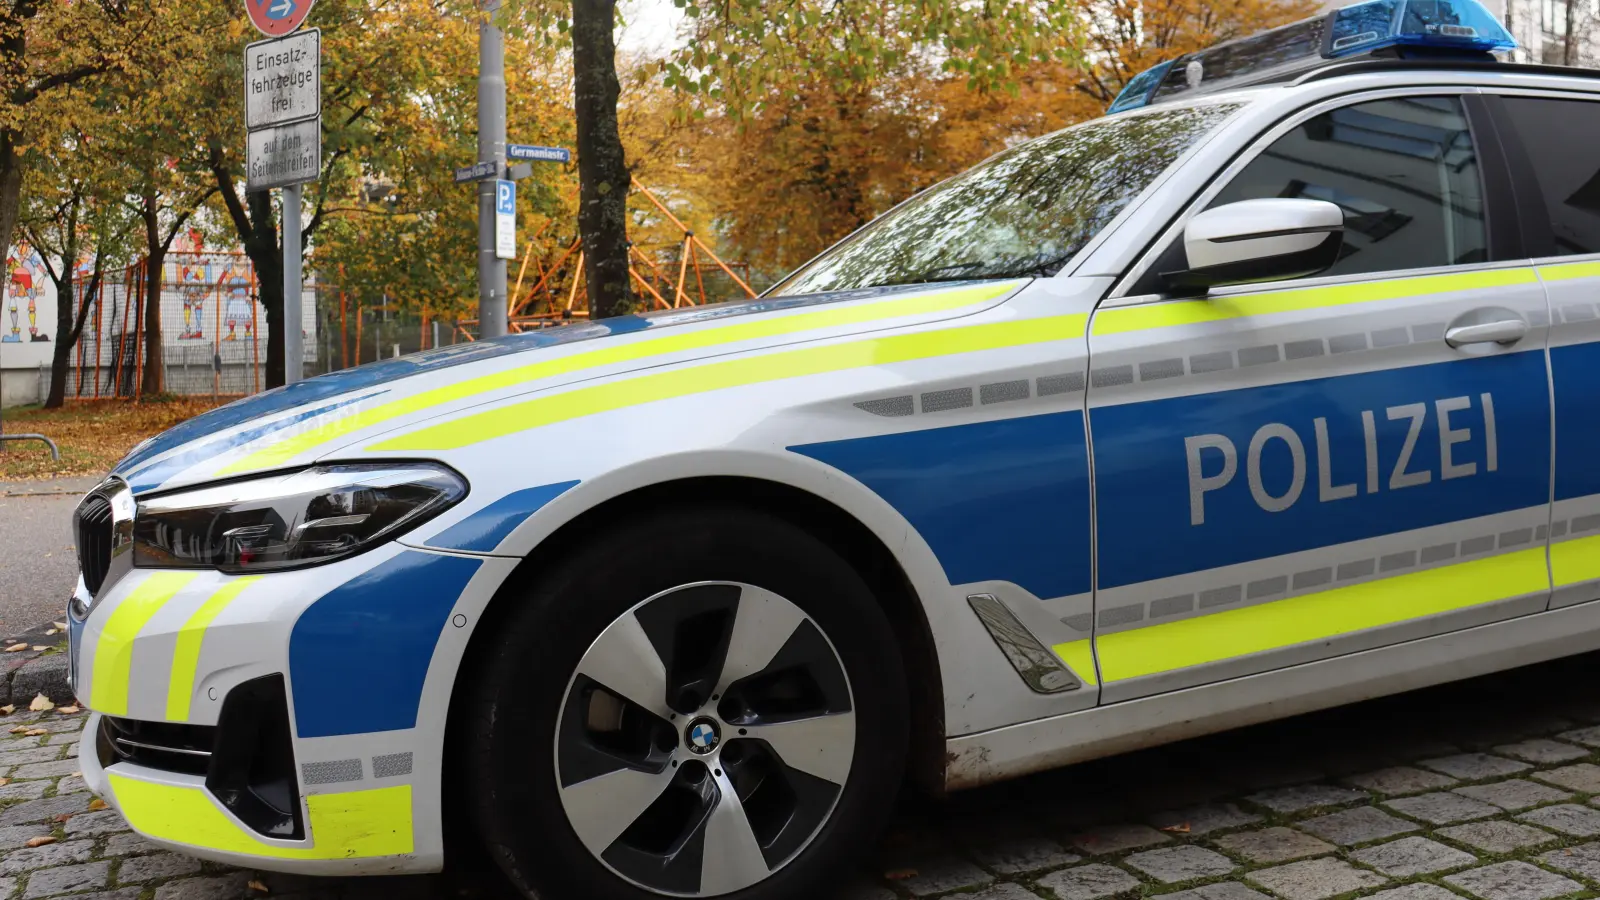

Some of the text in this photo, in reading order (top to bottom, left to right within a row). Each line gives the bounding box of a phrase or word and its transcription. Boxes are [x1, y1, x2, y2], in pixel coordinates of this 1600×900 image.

[256, 47, 307, 71] Einsatz-
[252, 70, 312, 94] fahrzeuge
[272, 92, 292, 112] frei
[263, 134, 301, 154] auf dem
[511, 146, 566, 160] Germaniastr.
[252, 153, 314, 178] Seitenstreifen
[1184, 393, 1498, 526] POLIZEI
